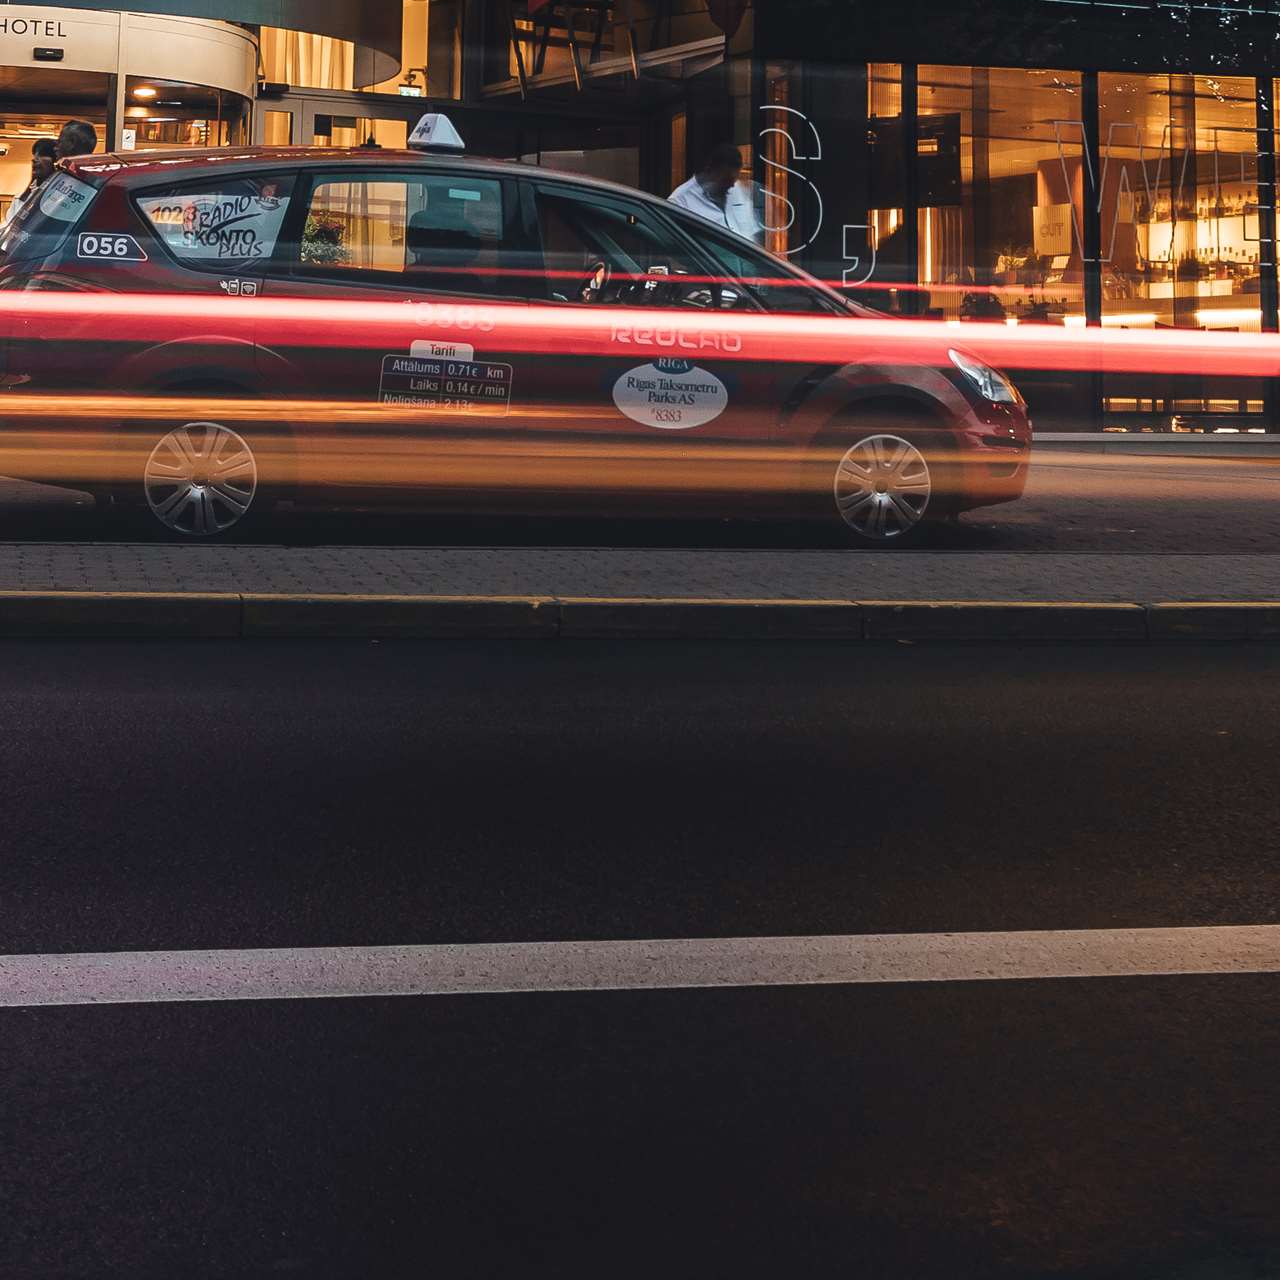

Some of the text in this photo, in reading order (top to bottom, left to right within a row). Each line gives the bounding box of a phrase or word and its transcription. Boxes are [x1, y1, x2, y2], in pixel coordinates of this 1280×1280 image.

[82, 236, 128, 256] 056
[218, 241, 263, 257] PLUS
[430, 343, 456, 357] Tarifi
[487, 367, 504, 379] km
[410, 378, 439, 391] Laiks
[657, 378, 718, 395] Taksometru
[647, 391, 696, 405] Parks AS
